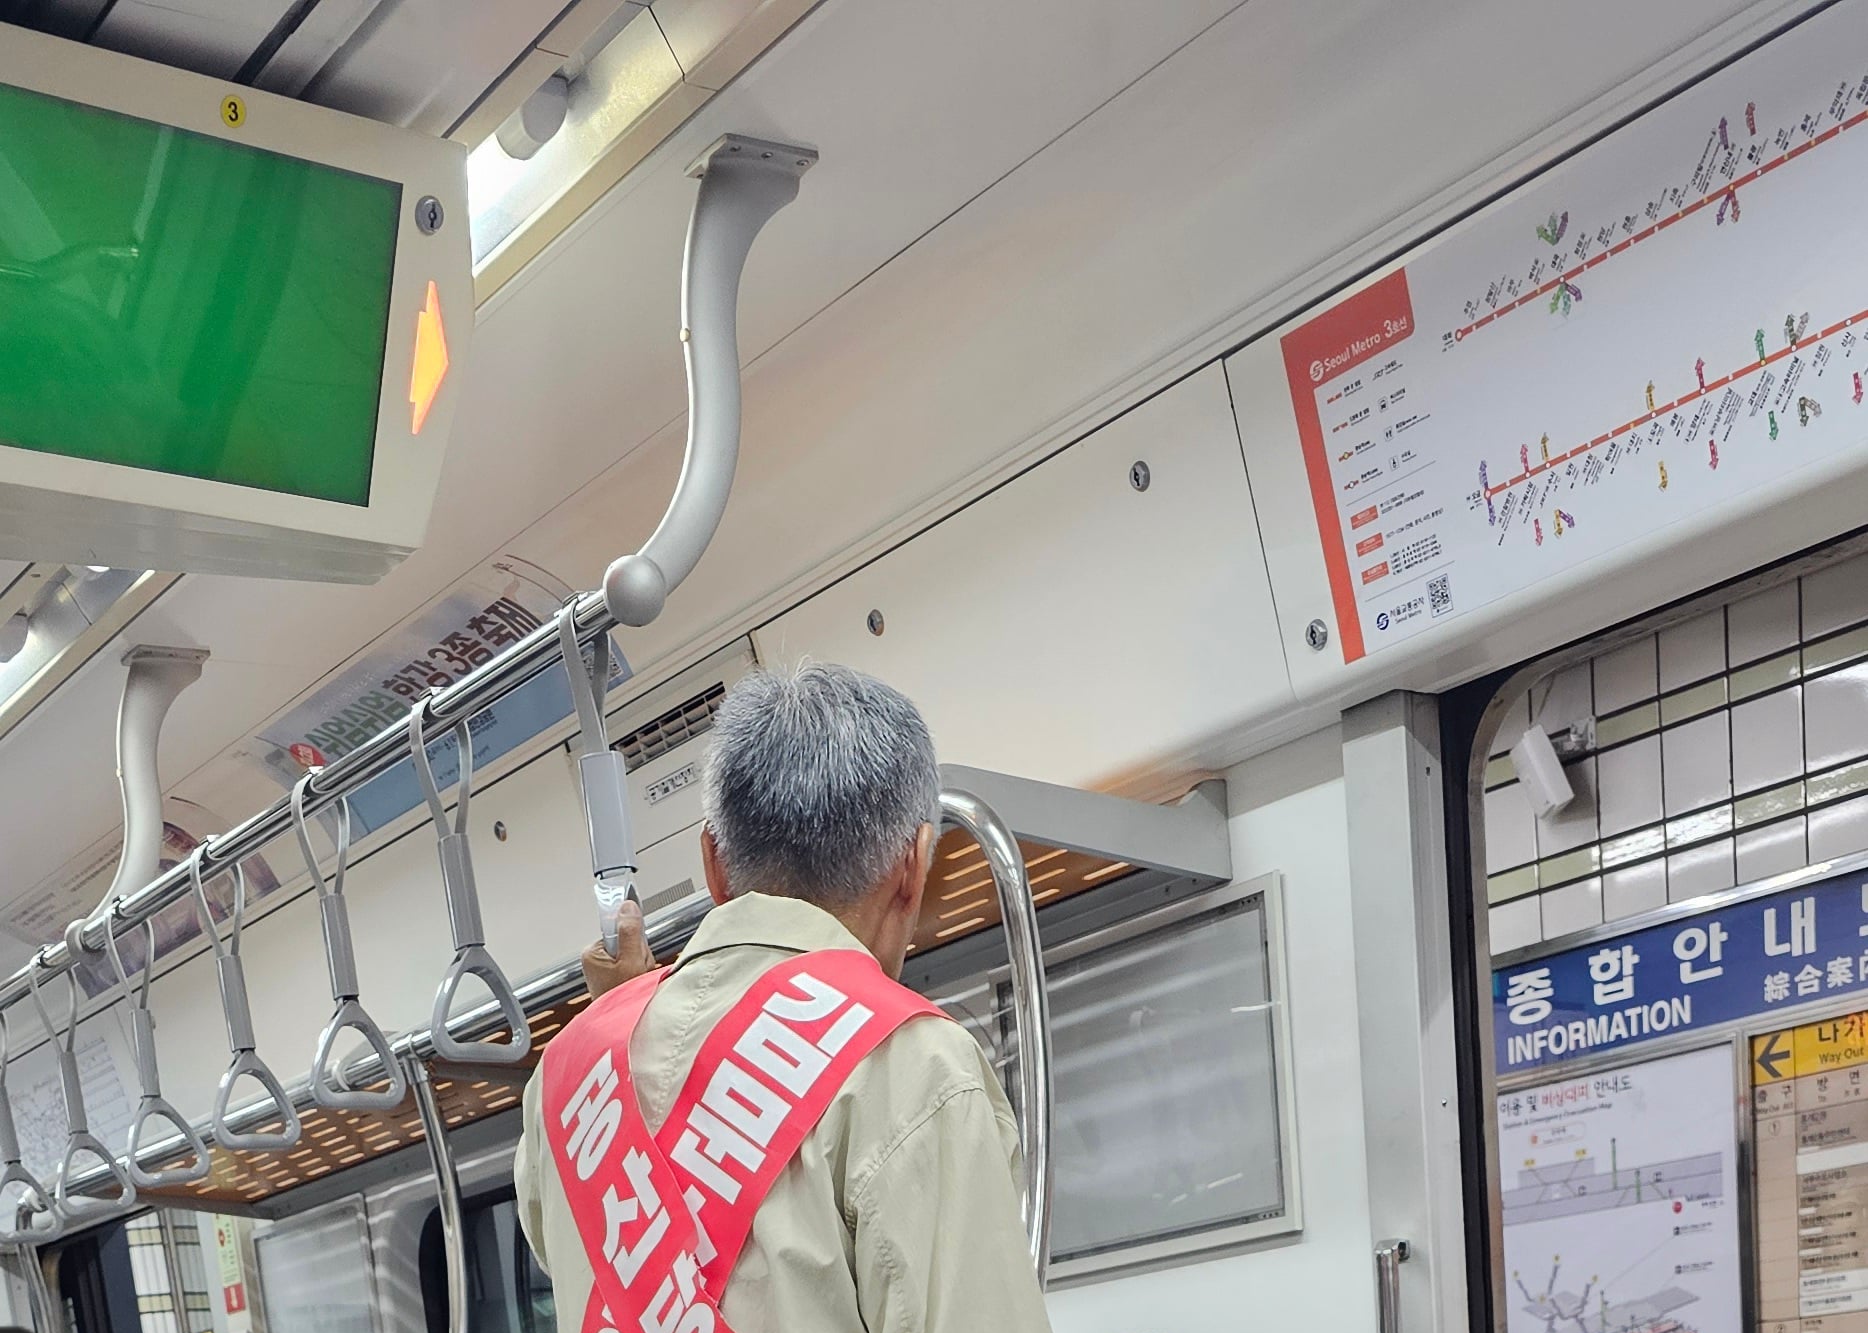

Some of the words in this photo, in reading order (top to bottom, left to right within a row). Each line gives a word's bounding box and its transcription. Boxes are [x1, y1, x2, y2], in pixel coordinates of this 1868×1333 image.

[228, 101, 238, 122] 3
[1323, 347, 1351, 373] Seoul
[1351, 332, 1381, 358] Metro
[1383, 316, 1408, 338] 3호선
[467, 597, 542, 647] 축제
[1507, 994, 1692, 1066] INFORMATION
[1818, 1052, 1842, 1065] Way
[1843, 1047, 1865, 1060] Out
[1500, 1097, 1523, 1117] 이용
[1526, 1095, 1538, 1113] 및
[1593, 1074, 1633, 1099] 안내도
